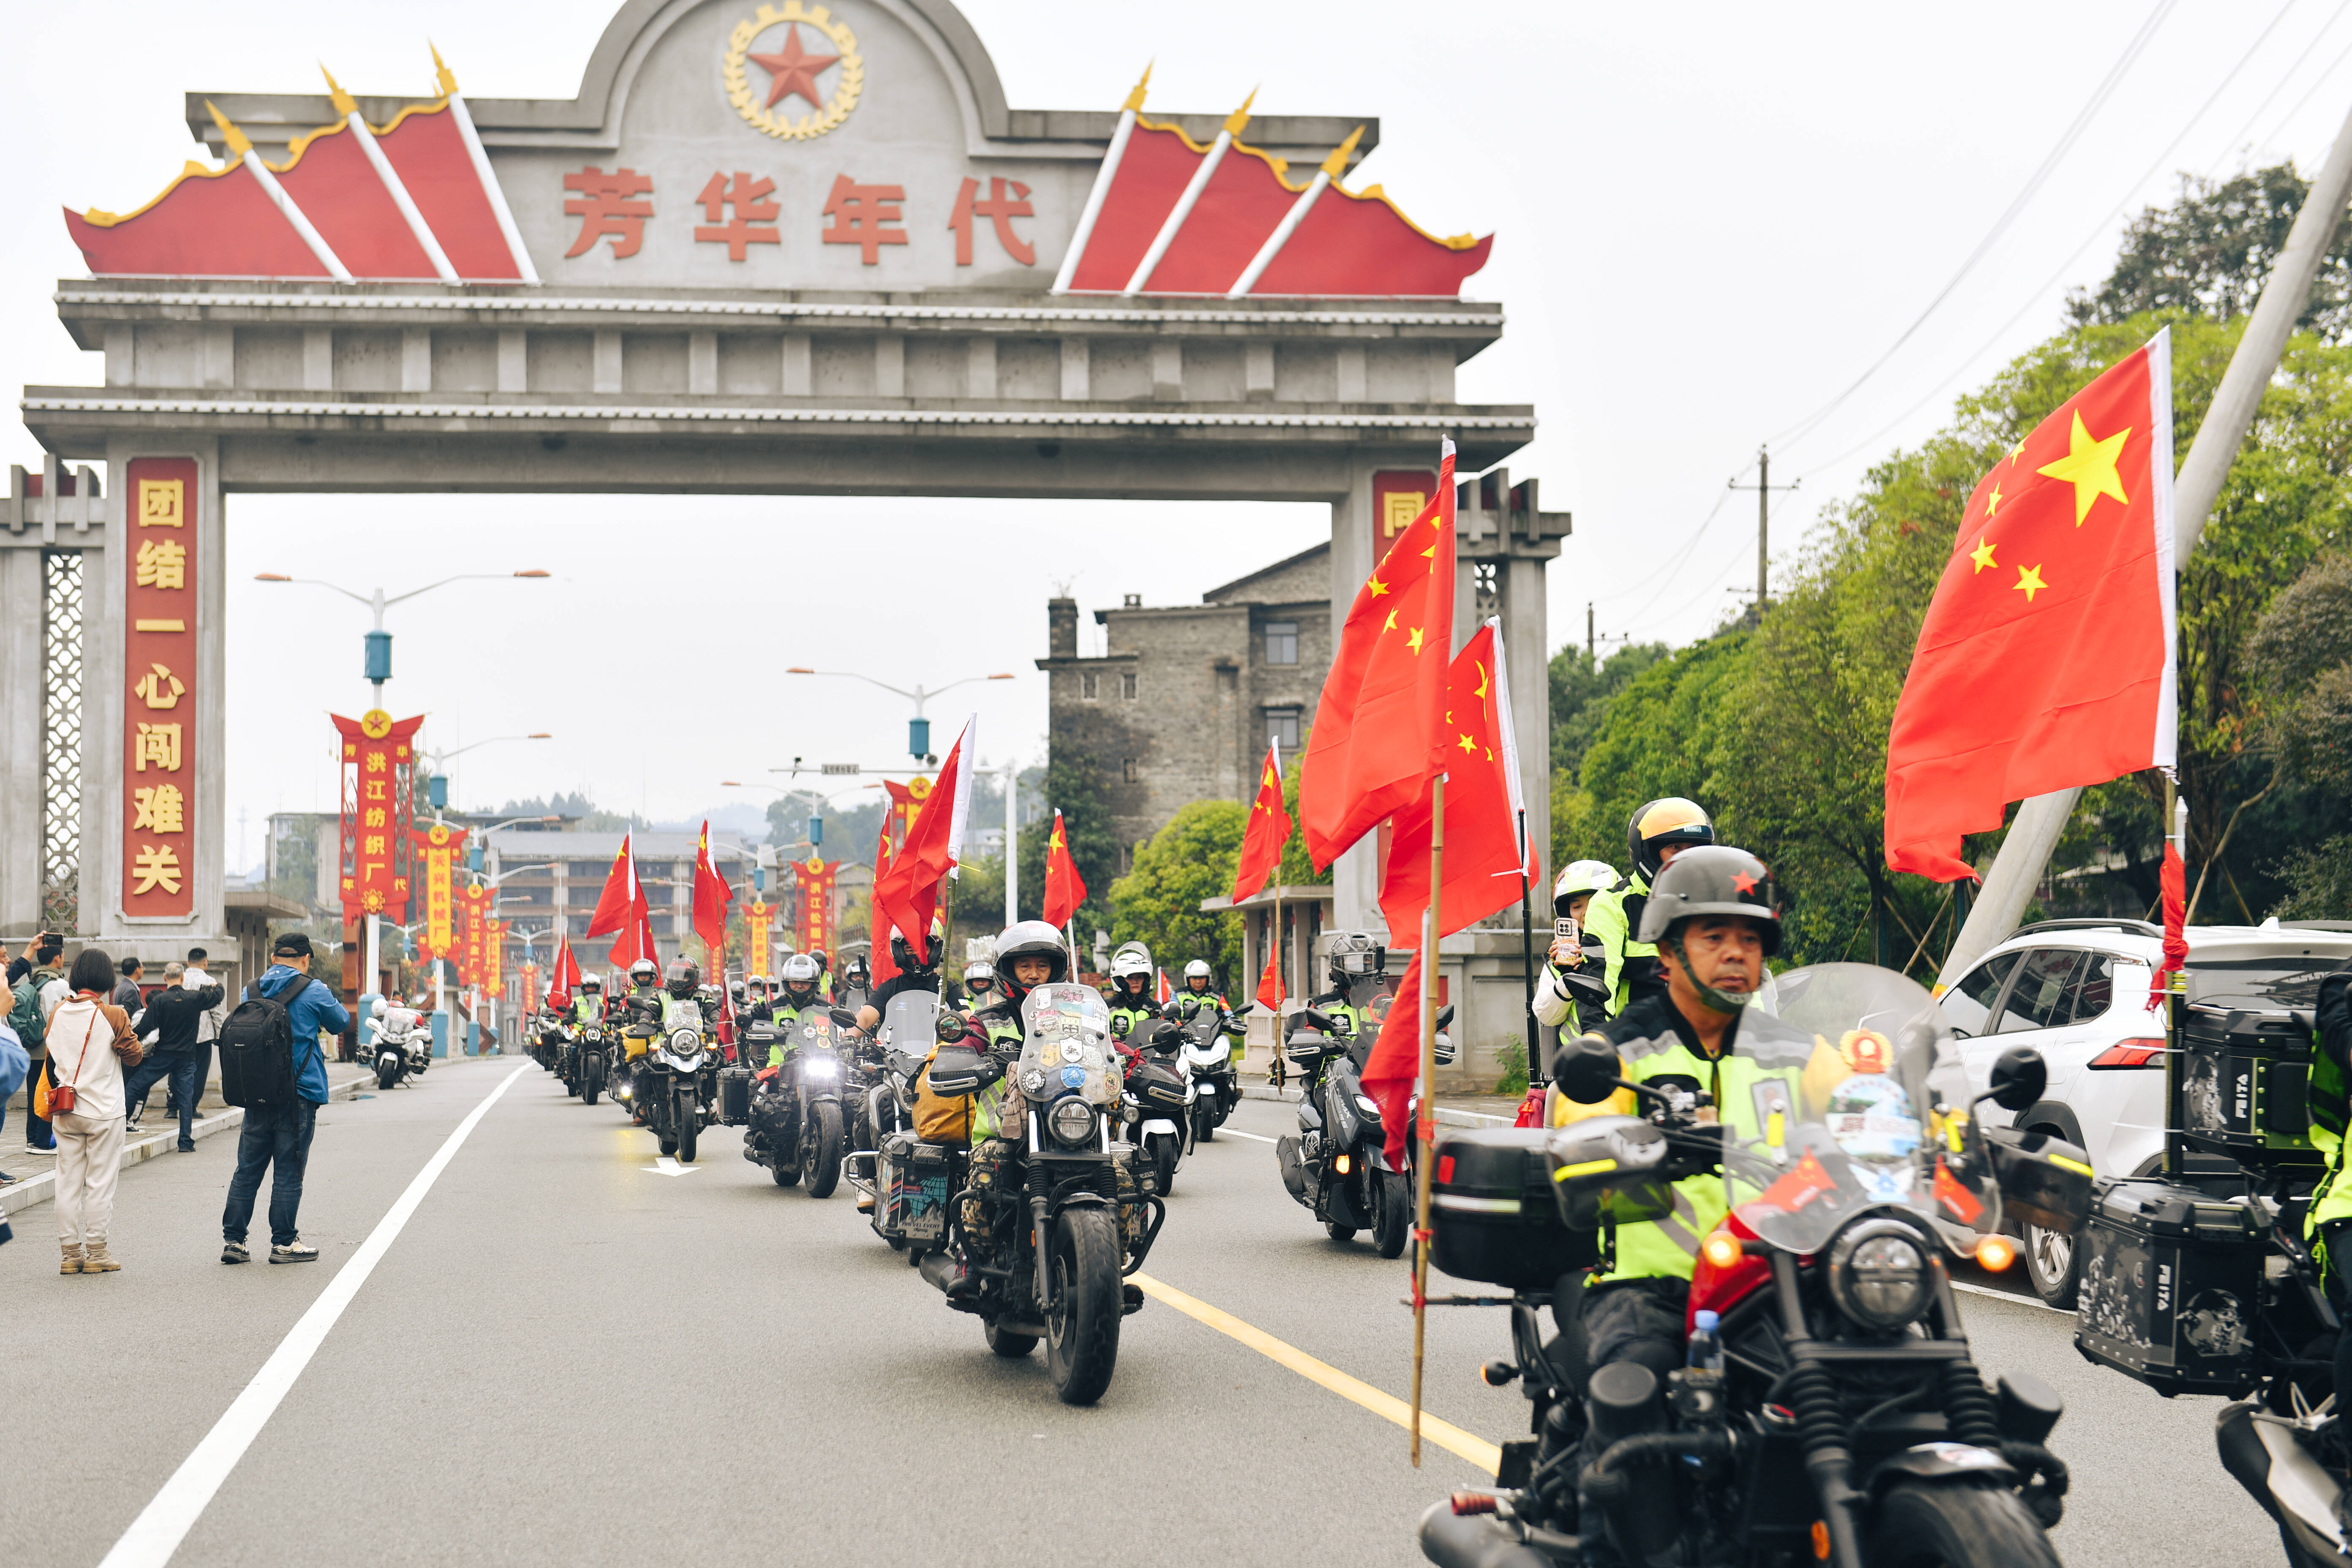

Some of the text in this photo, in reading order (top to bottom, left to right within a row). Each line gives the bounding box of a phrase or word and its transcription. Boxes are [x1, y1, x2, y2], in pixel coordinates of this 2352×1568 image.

[564, 166, 1035, 265] 芳华年代
[133, 478, 185, 895] 团结一心闯难关
[365, 752, 386, 883] 洪江纺织厂
[395, 878, 406, 891] 代
